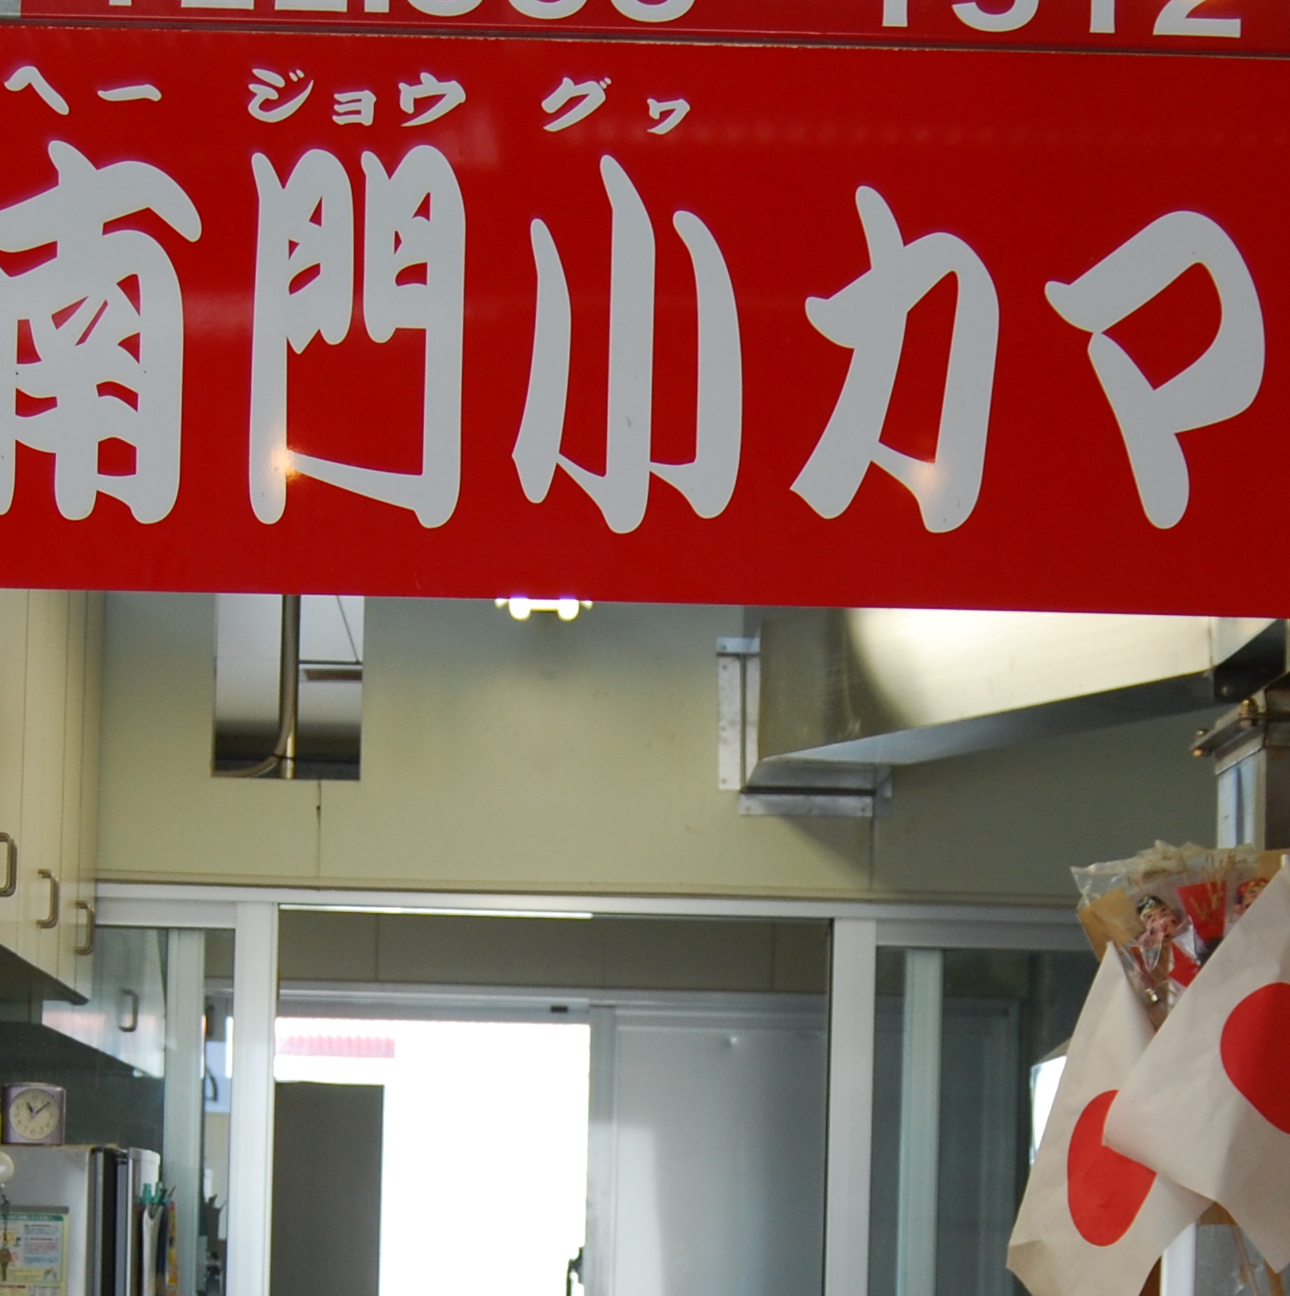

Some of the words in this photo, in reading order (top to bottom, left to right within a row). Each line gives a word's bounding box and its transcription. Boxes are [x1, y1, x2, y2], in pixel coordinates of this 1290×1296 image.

[5, 65, 161, 115] ヘー
[248, 67, 467, 128] ジョウ
